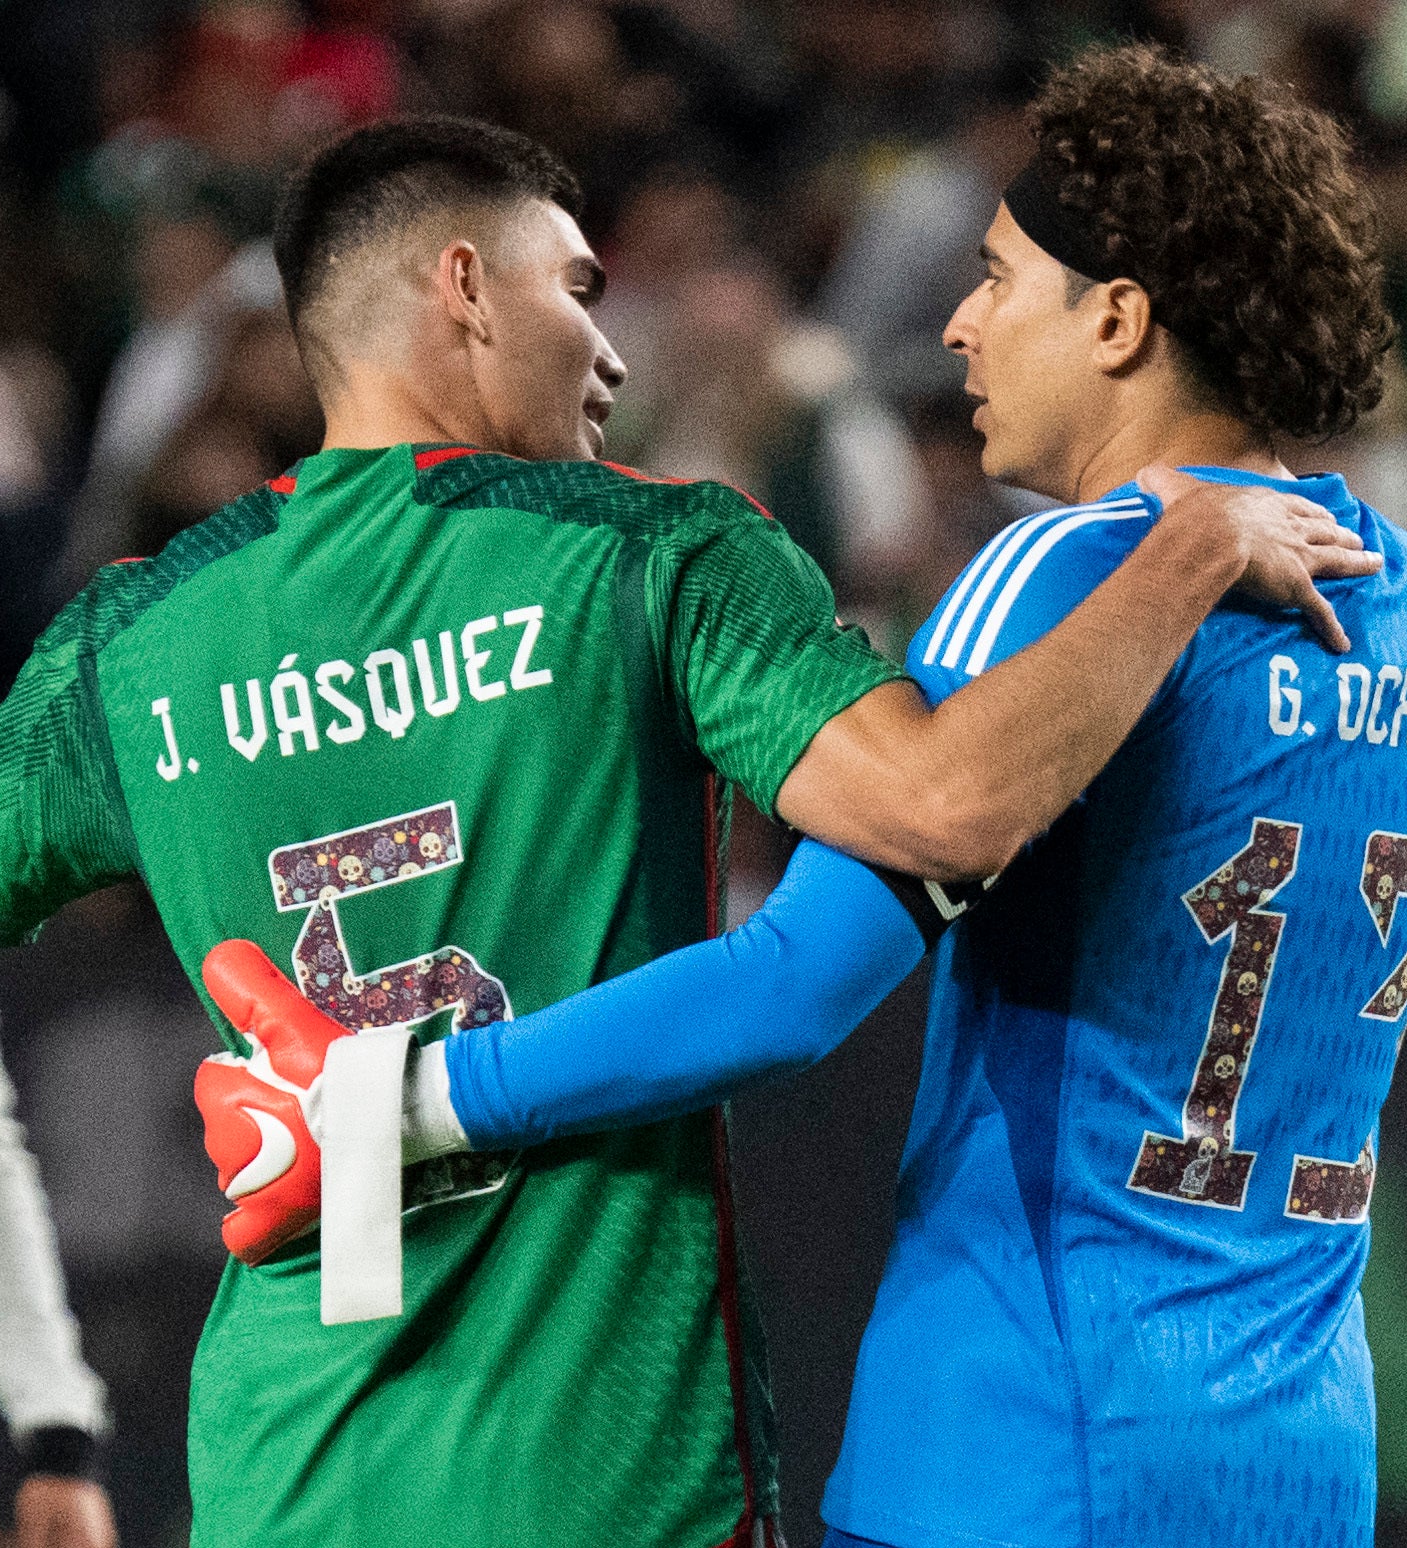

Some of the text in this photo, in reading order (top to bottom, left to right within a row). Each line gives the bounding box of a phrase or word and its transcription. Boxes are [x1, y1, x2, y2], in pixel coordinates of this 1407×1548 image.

[150, 604, 554, 782] J. VÁSQUEZ
[1268, 653, 1318, 738] G.
